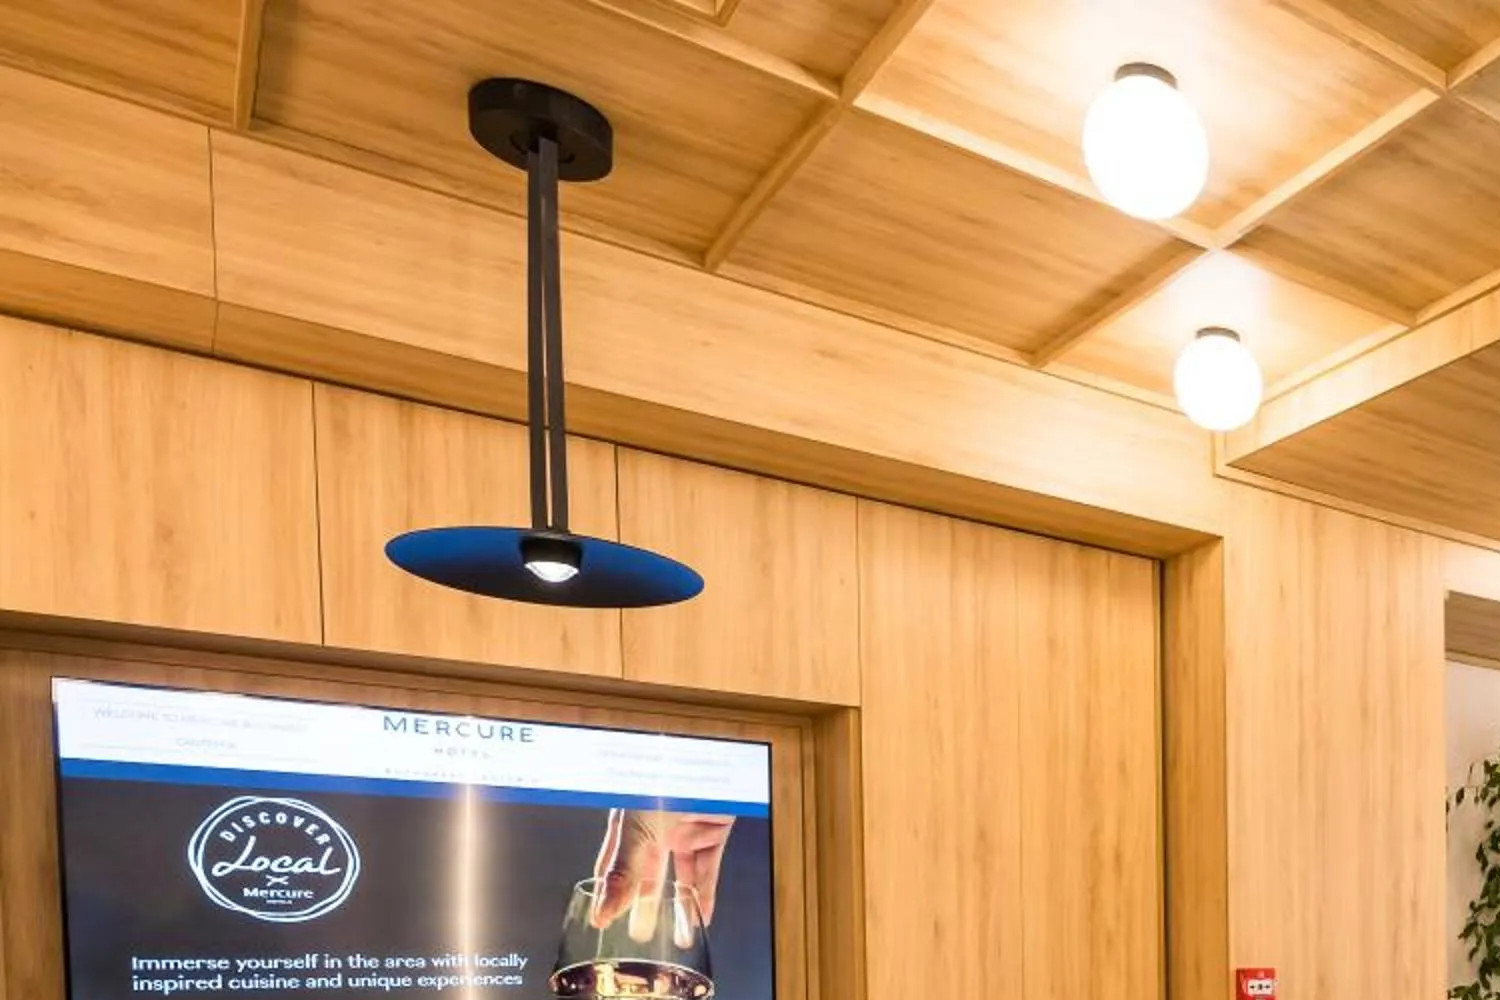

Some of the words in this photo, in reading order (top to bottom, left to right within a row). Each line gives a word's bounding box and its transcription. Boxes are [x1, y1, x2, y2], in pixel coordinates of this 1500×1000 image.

[383, 715, 535, 743] MERCURE
[219, 811, 332, 845] DISCOVER
[211, 835, 341, 876] Local
[243, 887, 314, 899] Mercure
[131, 956, 231, 971] Immerse
[236, 953, 319, 973] yourself
[323, 953, 342, 969] in
[347, 953, 380, 969] the
[385, 955, 426, 969] area
[431, 953, 468, 968] with
[475, 953, 528, 970] locally
[133, 974, 223, 995] inspired
[228, 973, 300, 990] cuisine
[305, 973, 342, 989] and
[348, 972, 412, 991] unique
